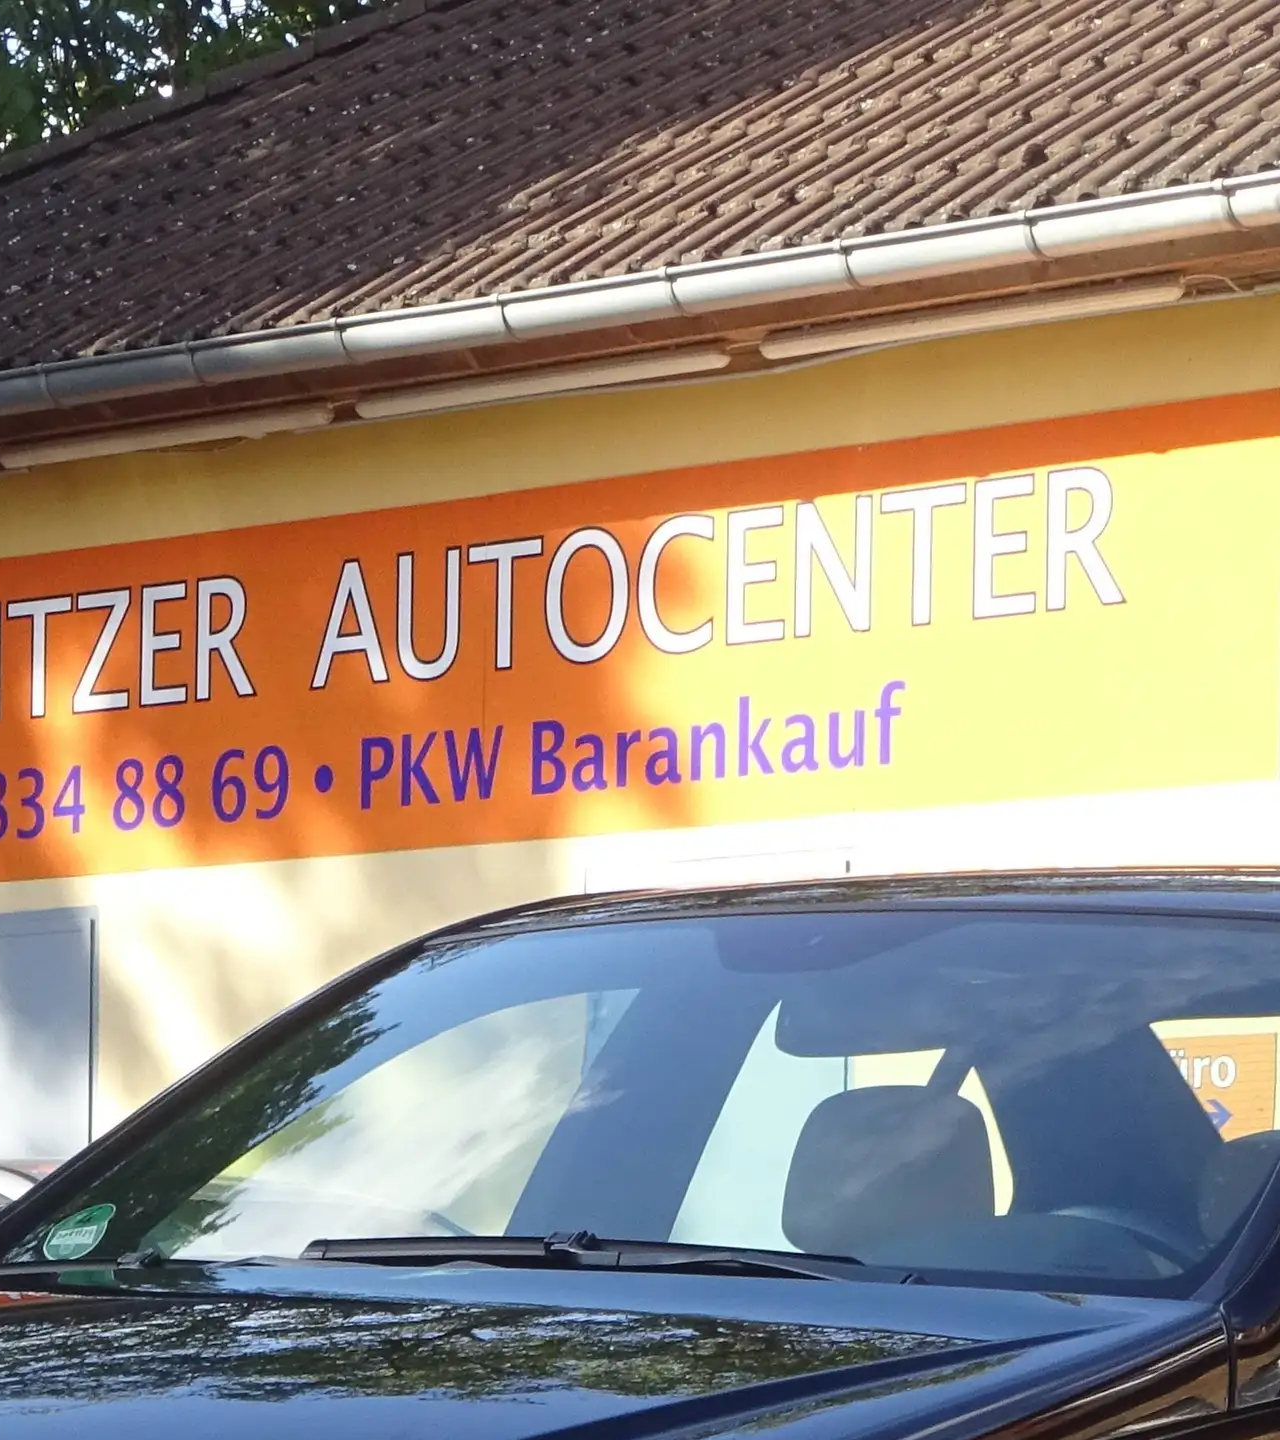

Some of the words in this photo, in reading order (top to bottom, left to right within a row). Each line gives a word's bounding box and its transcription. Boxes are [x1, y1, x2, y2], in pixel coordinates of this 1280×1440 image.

[309, 465, 1127, 692] AUTOCENTER
[113, 755, 188, 832] 88
[211, 745, 291, 824] 69
[360, 725, 503, 811] PKW
[529, 680, 906, 797] Barankauf
